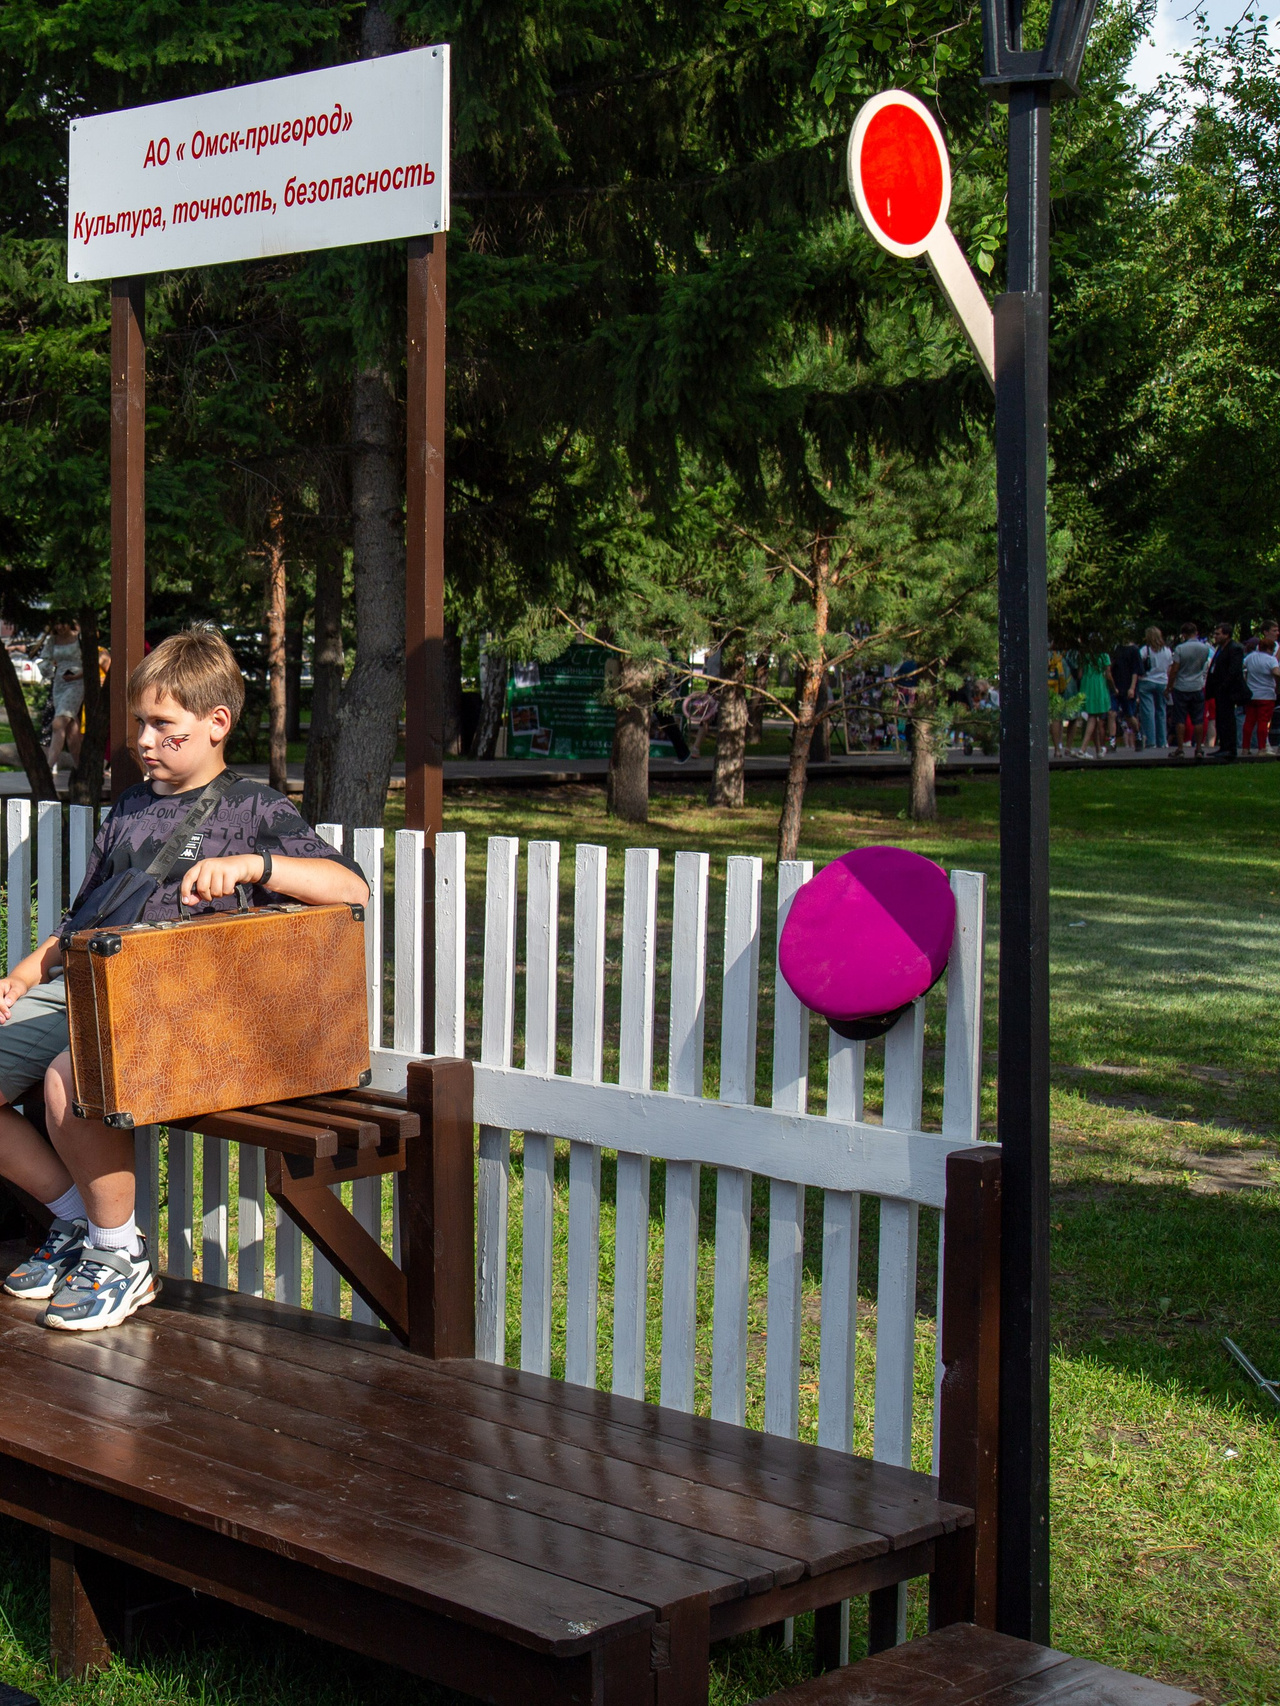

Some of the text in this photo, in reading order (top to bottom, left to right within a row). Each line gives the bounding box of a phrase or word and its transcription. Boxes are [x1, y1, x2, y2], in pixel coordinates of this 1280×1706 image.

[143, 137, 170, 168] АО
[73, 162, 435, 245] Культура, точность, безопасность
[128, 806, 177, 820] MOTION
[186, 798, 214, 828] FILA
[161, 834, 188, 865] FILA
